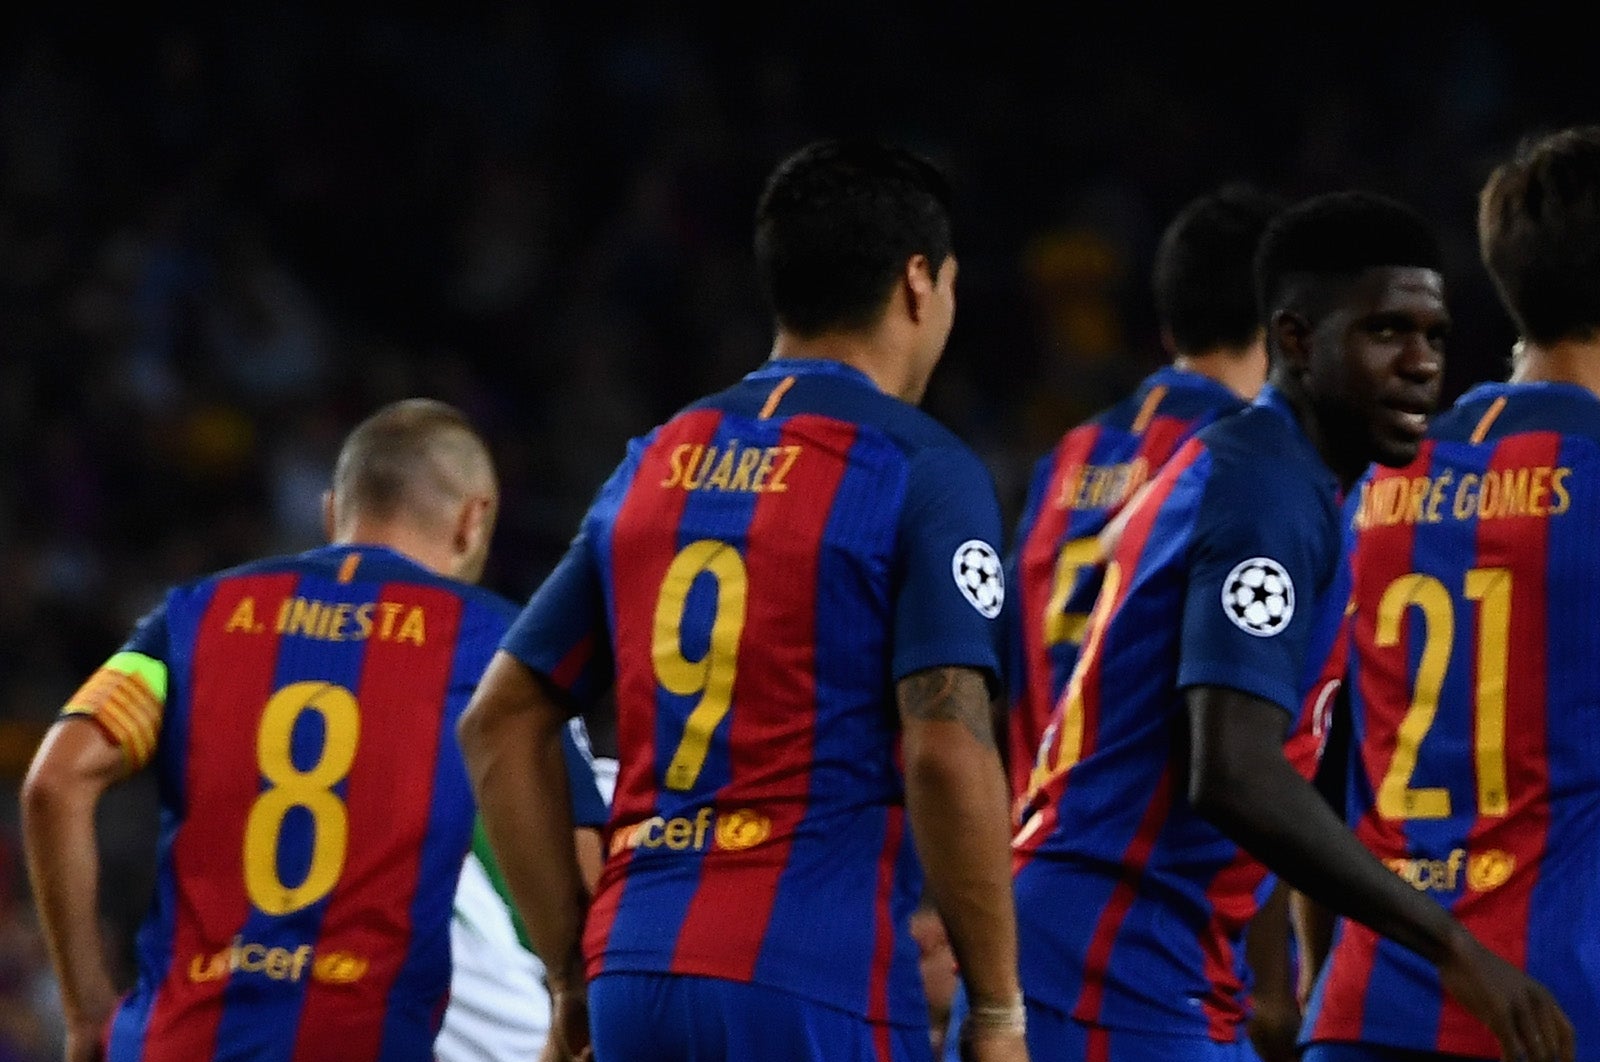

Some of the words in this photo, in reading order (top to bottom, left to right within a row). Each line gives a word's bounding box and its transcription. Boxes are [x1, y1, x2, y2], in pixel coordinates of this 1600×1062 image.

[660, 438, 802, 493] SUÁREZ
[1453, 466, 1572, 520] GOMES
[225, 597, 265, 633] A.
[275, 596, 426, 647] INIESTA
[652, 540, 747, 791] 9
[1376, 568, 1512, 819] 21
[242, 681, 361, 916] 8
